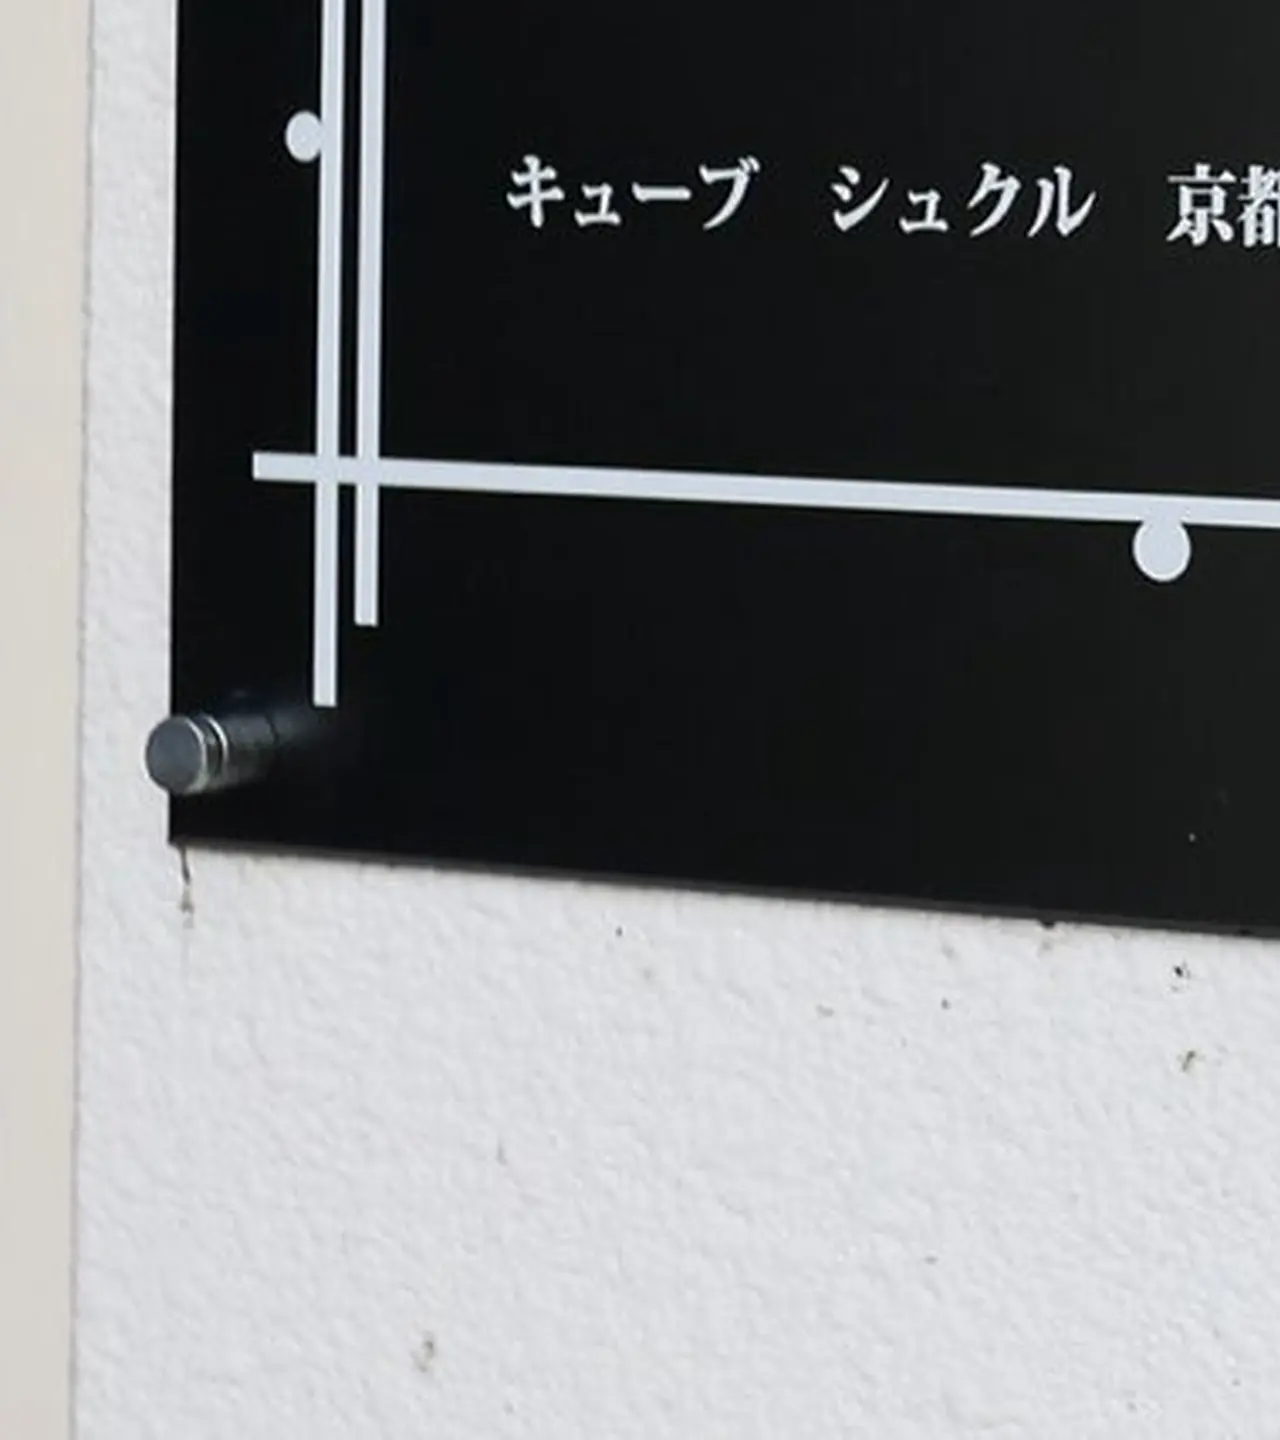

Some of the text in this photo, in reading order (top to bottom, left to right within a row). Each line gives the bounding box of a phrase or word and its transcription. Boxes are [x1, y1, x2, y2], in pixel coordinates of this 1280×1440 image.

[505, 154, 761, 230] キューブ
[829, 161, 1097, 239] シュクル
